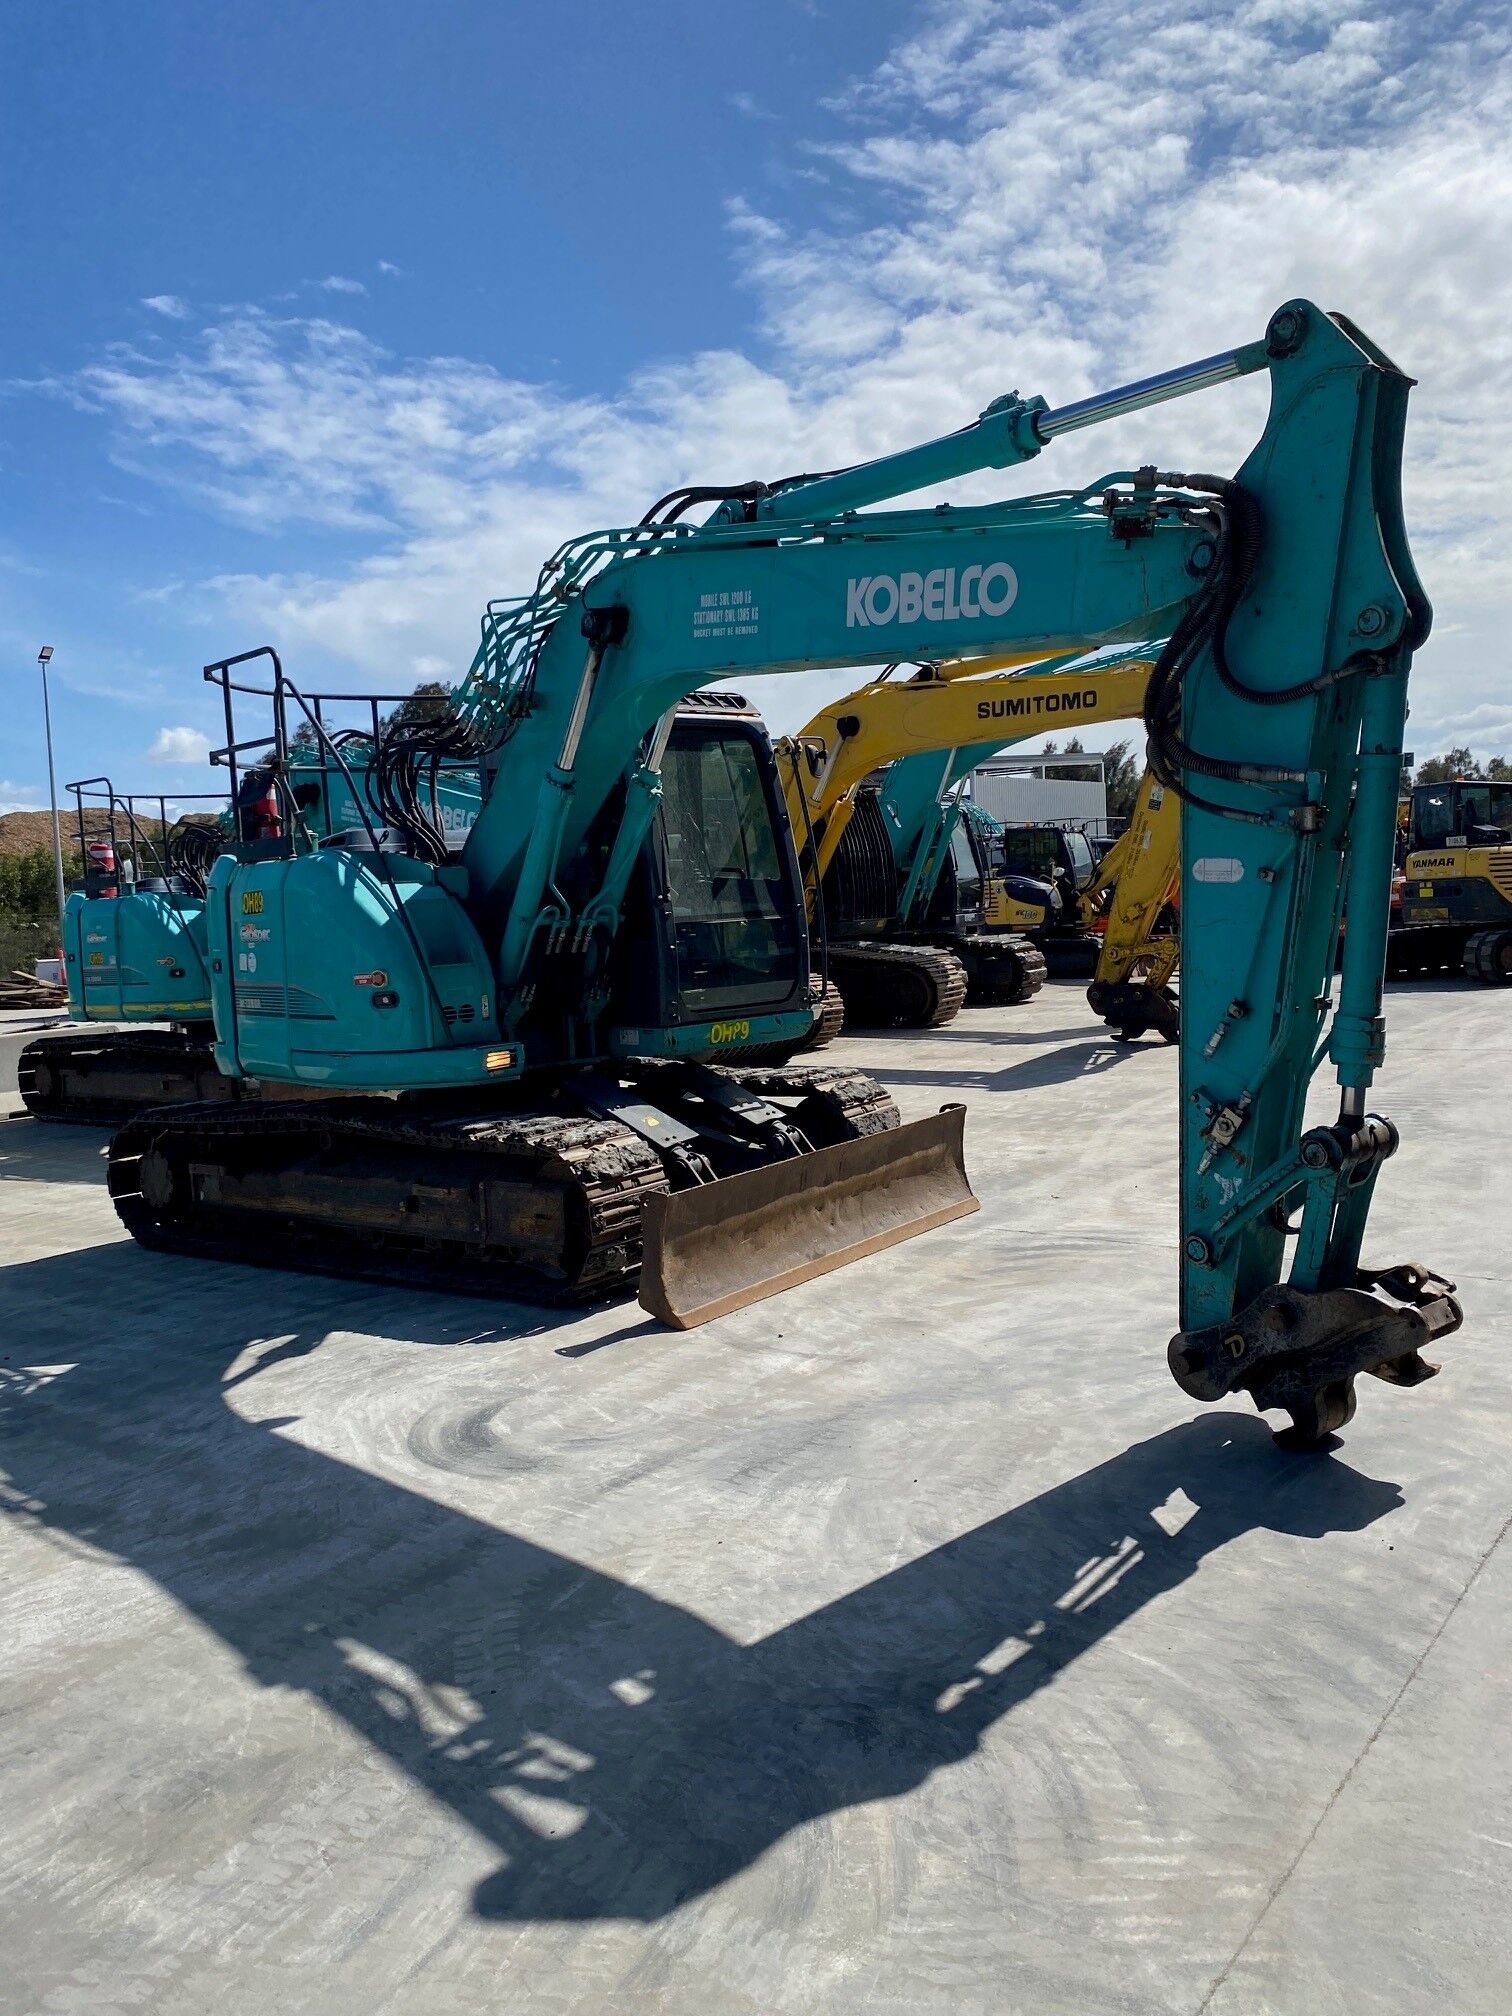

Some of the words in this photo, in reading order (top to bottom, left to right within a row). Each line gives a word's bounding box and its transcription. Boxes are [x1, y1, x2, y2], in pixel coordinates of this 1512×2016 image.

[719, 593, 730, 605] SWL
[846, 561, 1018, 628] KOBELCO
[693, 610, 723, 624] STATIONARY
[724, 609, 736, 622] SWL
[751, 607, 759, 619] KG
[693, 628, 711, 637] BUCKET
[712, 627, 726, 636] MUST
[727, 626, 734, 635] BE
[735, 625, 759, 634] REMOVED
[977, 690, 1098, 719] SUMITOMO
[1412, 857, 1456, 869] YANMAR
